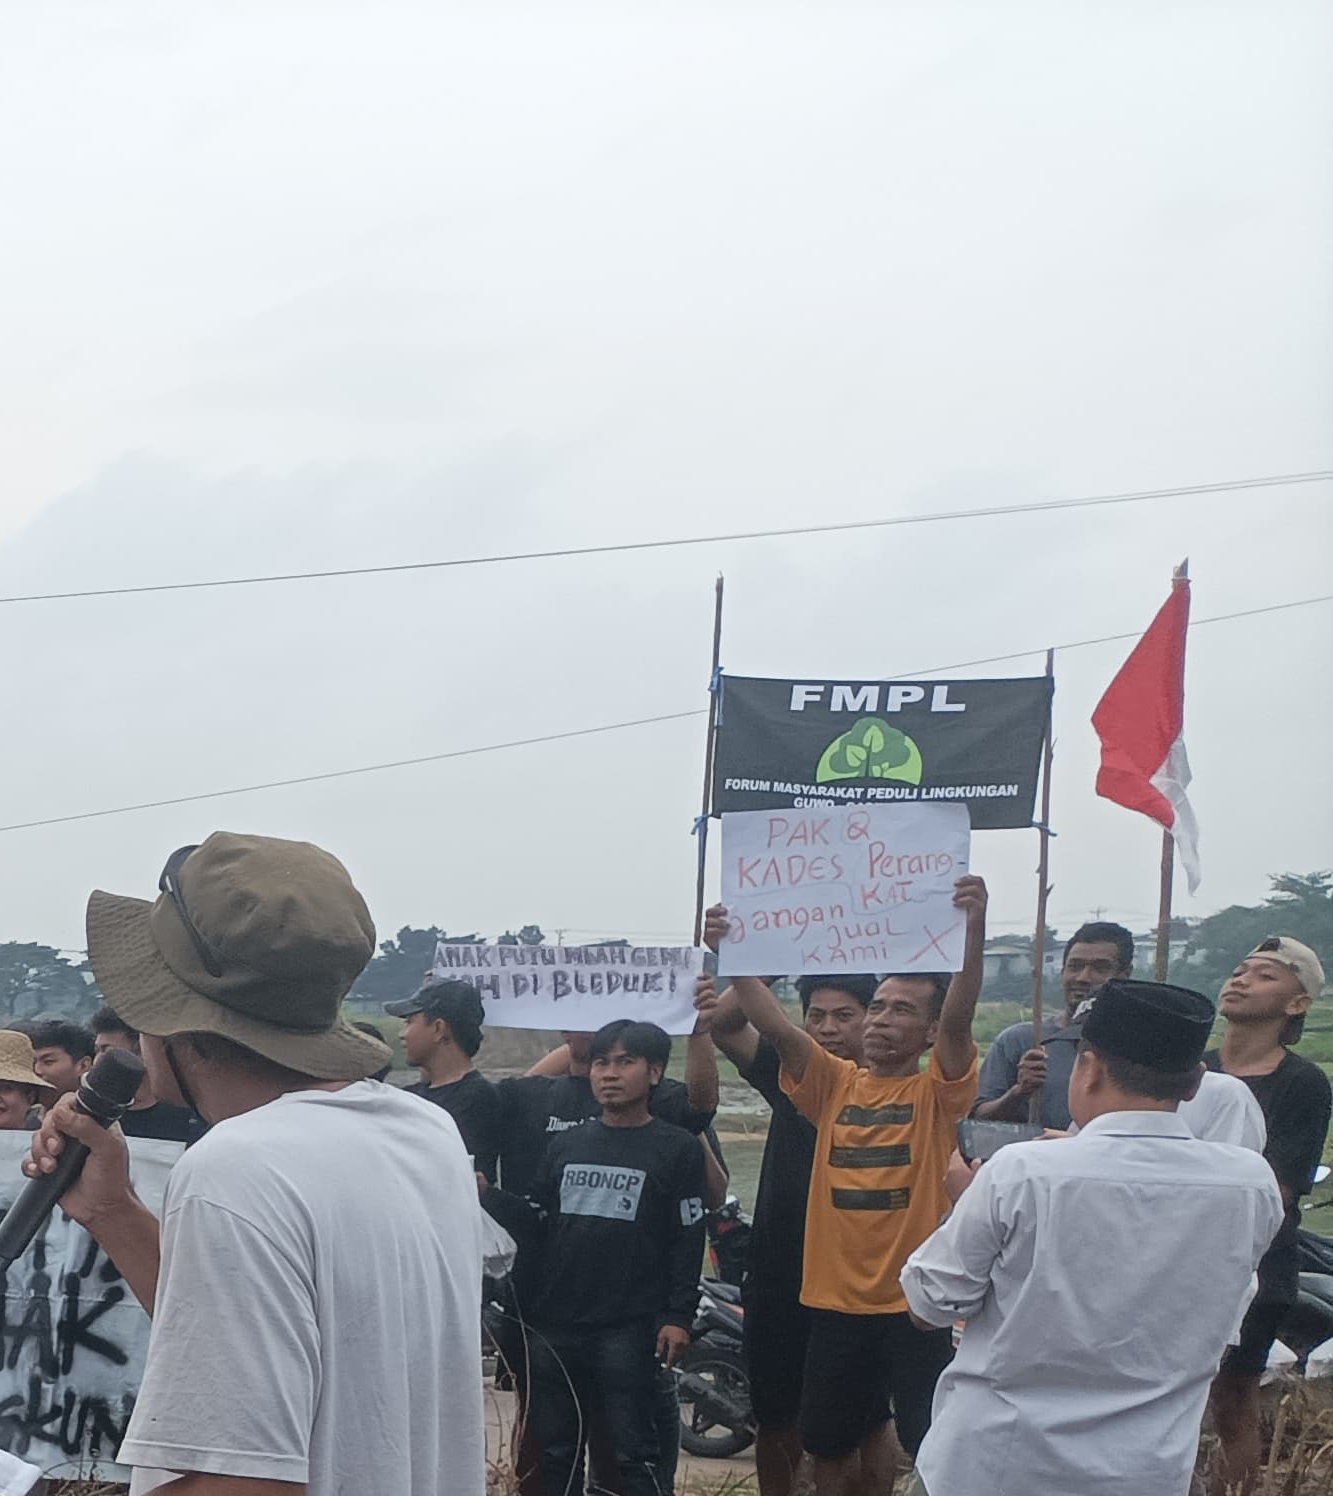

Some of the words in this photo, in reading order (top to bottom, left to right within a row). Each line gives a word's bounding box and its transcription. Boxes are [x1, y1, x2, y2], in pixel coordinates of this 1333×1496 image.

[790, 684, 966, 712] FMPL
[725, 778, 770, 793] FORUM
[773, 782, 863, 800] MASYARAKAT
[866, 787, 917, 801] PEDULI
[921, 783, 1019, 799] LINGKUNGAN
[767, 817, 831, 848] PAK
[738, 854, 843, 889] KADES
